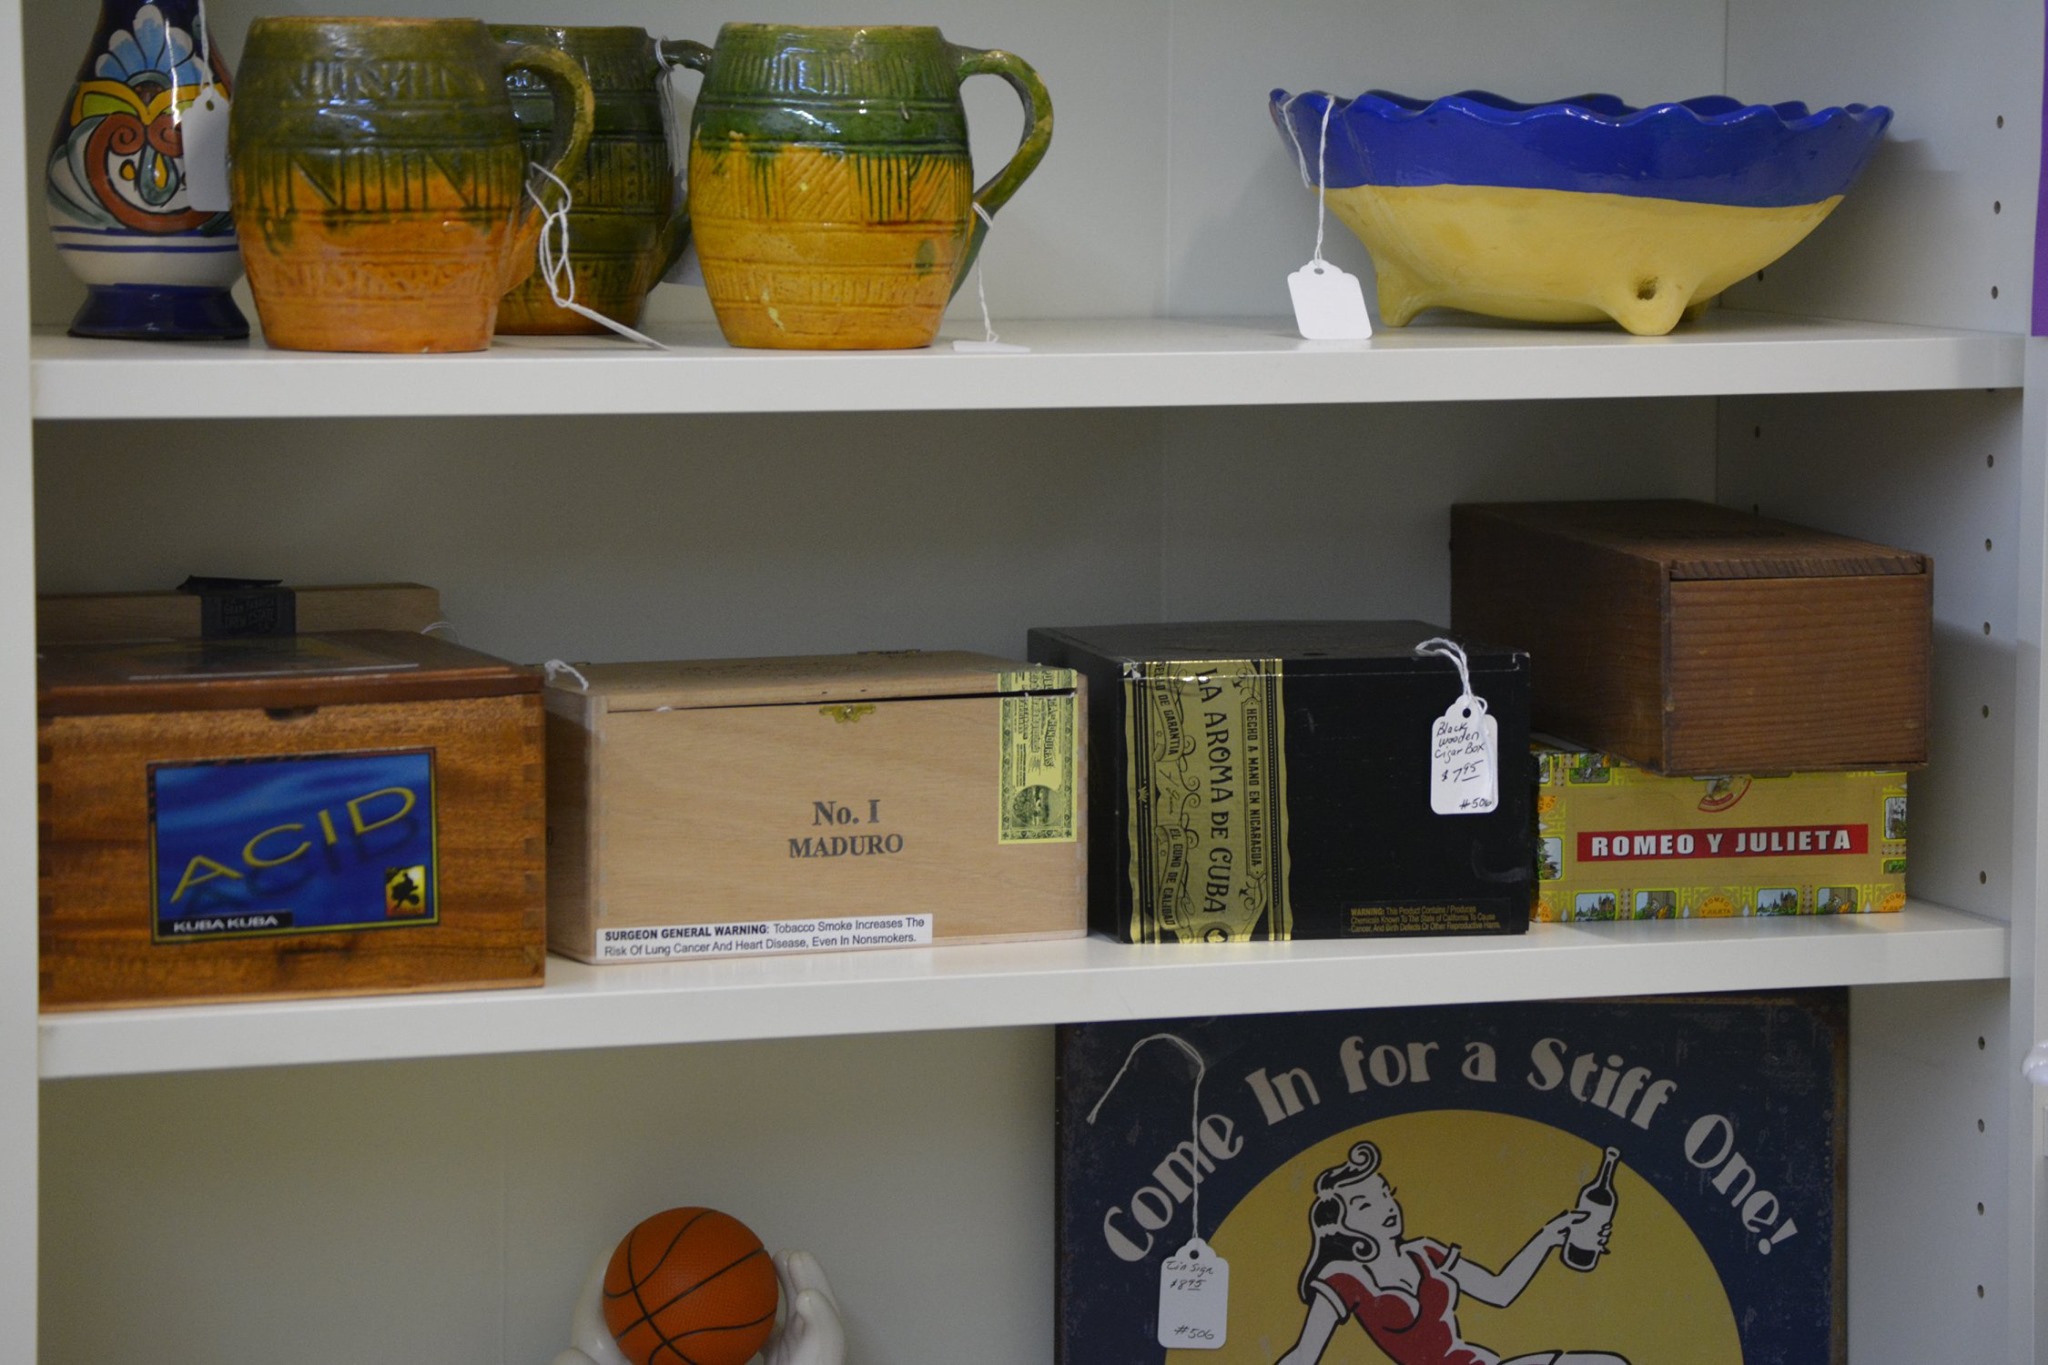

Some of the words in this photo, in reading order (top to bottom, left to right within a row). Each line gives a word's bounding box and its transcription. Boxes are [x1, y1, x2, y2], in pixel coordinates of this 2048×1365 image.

[1195, 668, 1223, 703] LA
[1158, 694, 1171, 707] DE
[1247, 708, 1258, 741] HECHO
[1437, 721, 1468, 738] Black
[1204, 712, 1234, 803] AROMA
[1465, 742, 1486, 755] Box
[1249, 757, 1260, 786] MANO
[1249, 791, 1260, 804] EN
[812, 800, 860, 826] No.
[1211, 811, 1229, 839] DE
[170, 787, 416, 903] ACID
[788, 833, 904, 858] MADURO
[1169, 828, 1182, 840] EL
[1250, 809, 1262, 867] NICARAGUA
[1592, 834, 1695, 857] ROMEO
[1707, 833, 1723, 854] Y
[1735, 829, 1851, 853] JULIETA
[1203, 847, 1233, 913] CUBA
[1162, 887, 1176, 926] CALIDAD
[173, 918, 225, 933] KUBA
[227, 915, 278, 931] KUBA
[605, 929, 658, 942] SURGEON
[661, 927, 711, 939] GENERAL
[714, 924, 769, 937] WARNING:
[773, 922, 815, 934] Tobacco
[818, 920, 852, 932] Smoke
[855, 918, 903, 930] Increases
[905, 917, 925, 928] The
[604, 945, 627, 957] Risk
[630, 944, 644, 956] Of
[645, 943, 671, 957] Lung
[674, 942, 709, 954] Cancer
[712, 940, 732, 952] And
[735, 939, 763, 951] Heart
[766, 937, 809, 950] Disease,
[812, 936, 837, 948] Even
[840, 935, 850, 946] In
[852, 933, 916, 946] Nonsmokers.
[1104, 1114, 1244, 1262] Come
[1245, 1067, 1321, 1126] In
[1340, 1035, 1440, 1094] for
[1461, 1041, 1497, 1083] a
[1527, 1037, 1678, 1131] Stiff
[1684, 1114, 1799, 1256] One!
[1166, 1261, 1187, 1271] Tin
[1174, 1325, 1215, 1340] #506
